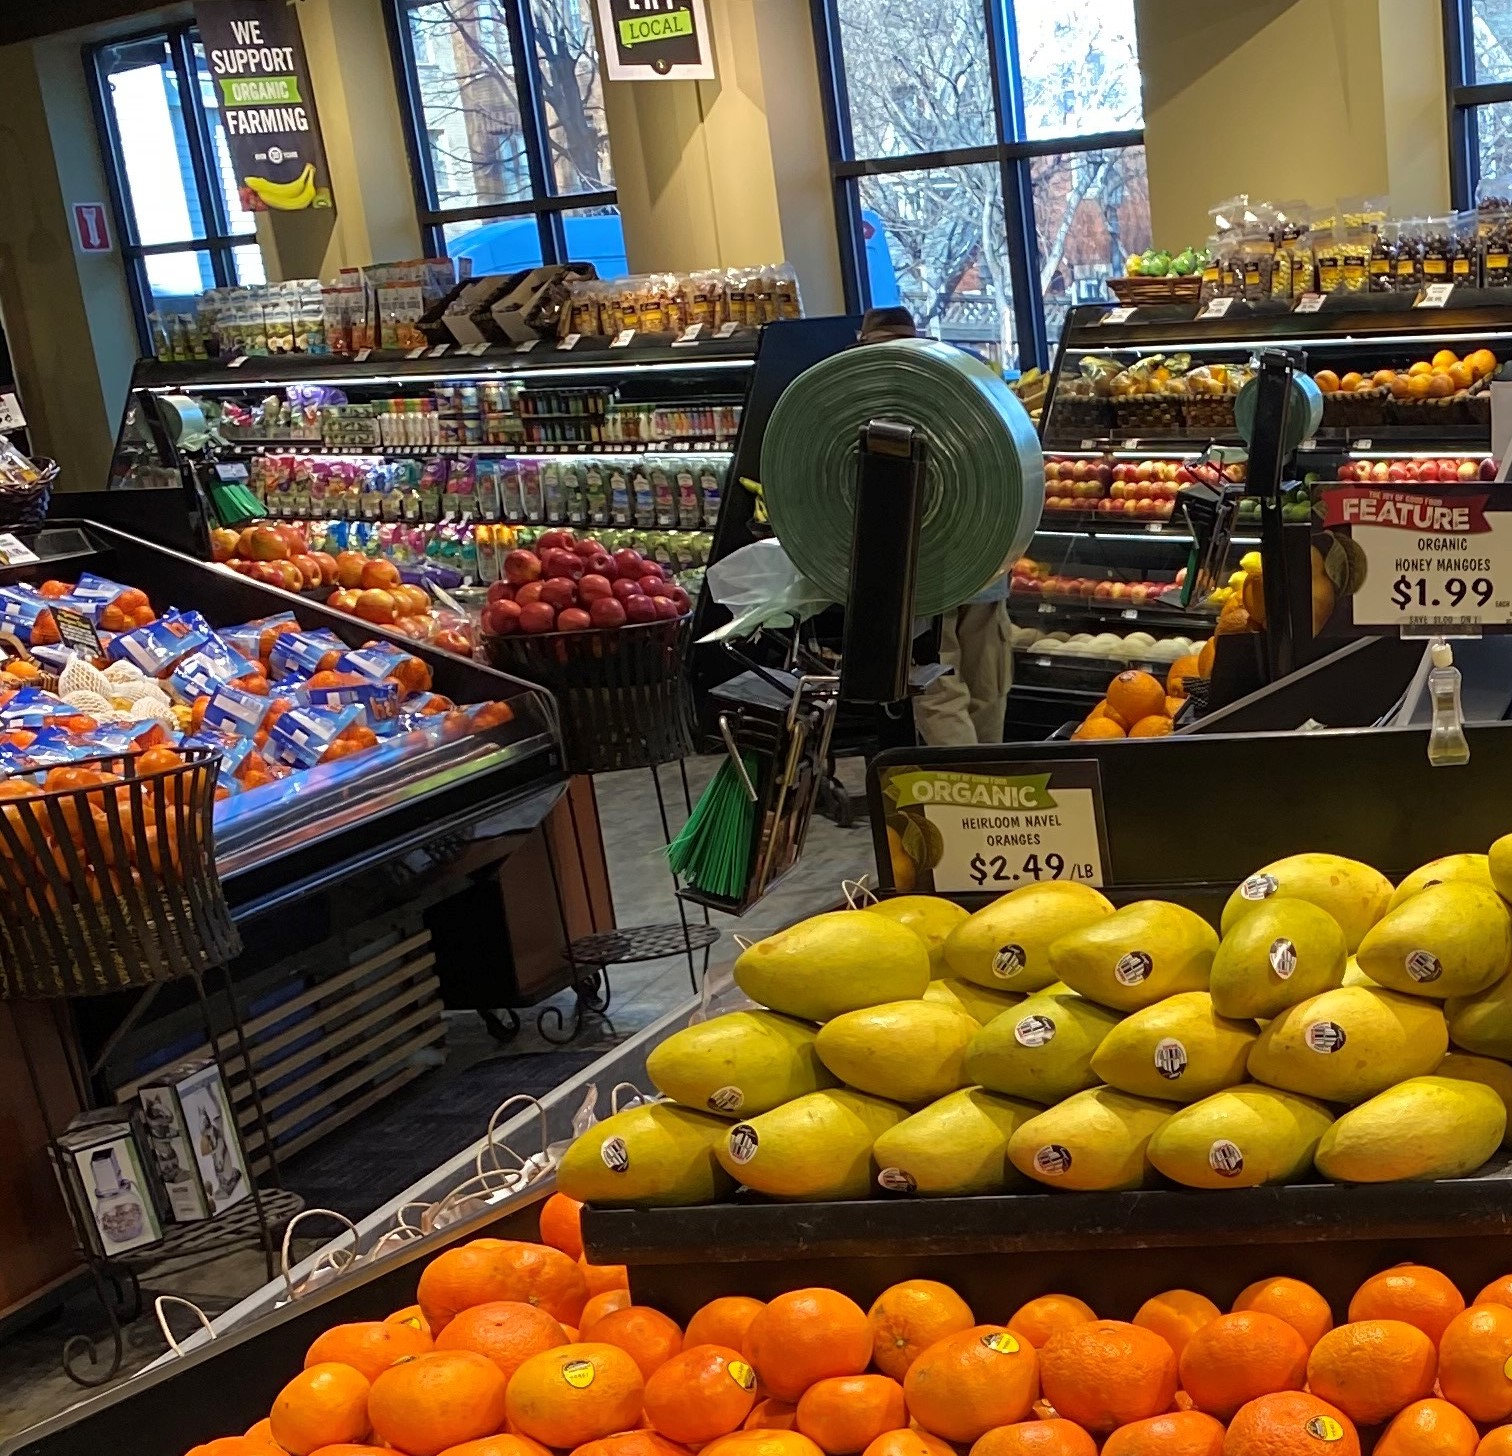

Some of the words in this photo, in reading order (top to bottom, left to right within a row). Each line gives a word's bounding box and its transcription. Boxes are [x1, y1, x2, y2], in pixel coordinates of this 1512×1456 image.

[230, 20, 264, 45] WE
[629, 16, 683, 39] LOCAL
[211, 47, 295, 74] SUPPORT
[231, 80, 290, 102] ORGANIC
[226, 107, 309, 135] FARMING
[1342, 498, 1470, 531] FEATURE
[1418, 538, 1468, 551] ORGANIC
[1395, 558, 1432, 572] HONEY
[1437, 558, 1491, 572] MANGOES
[1391, 574, 1493, 610] $1.99
[912, 780, 1038, 808] ORGANIC
[961, 816, 1020, 830] HEIRLOOM
[1025, 814, 1062, 827] NAVEL
[986, 833, 1041, 846] ORANGES
[969, 853, 1065, 885] $2.49
